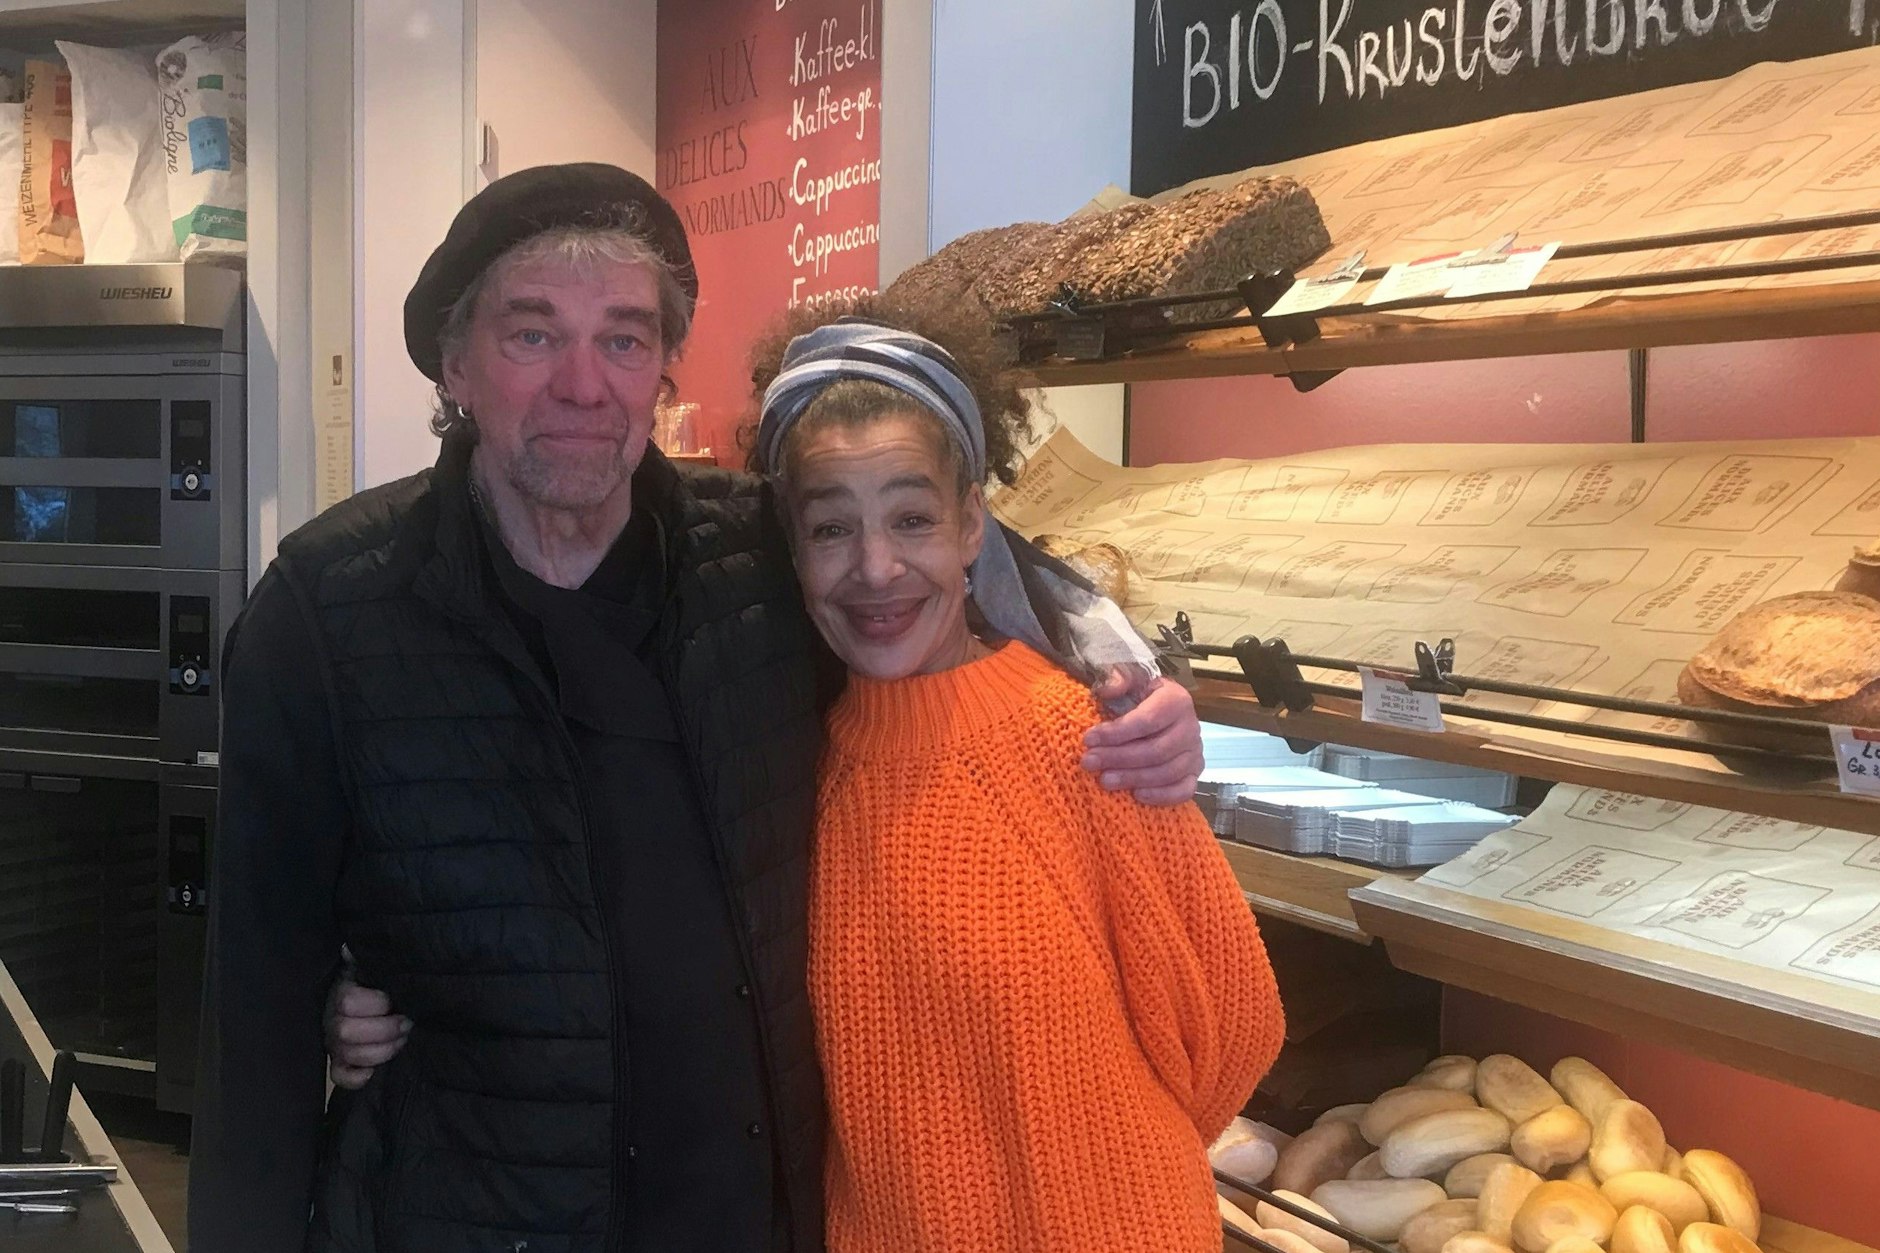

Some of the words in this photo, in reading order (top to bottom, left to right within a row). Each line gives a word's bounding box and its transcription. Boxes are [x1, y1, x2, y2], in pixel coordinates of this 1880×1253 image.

[700, 35, 759, 115] AUX
[665, 120, 748, 190] DELICES
[685, 177, 786, 236] NORMANDS
[100, 287, 173, 300] WIESHEU
